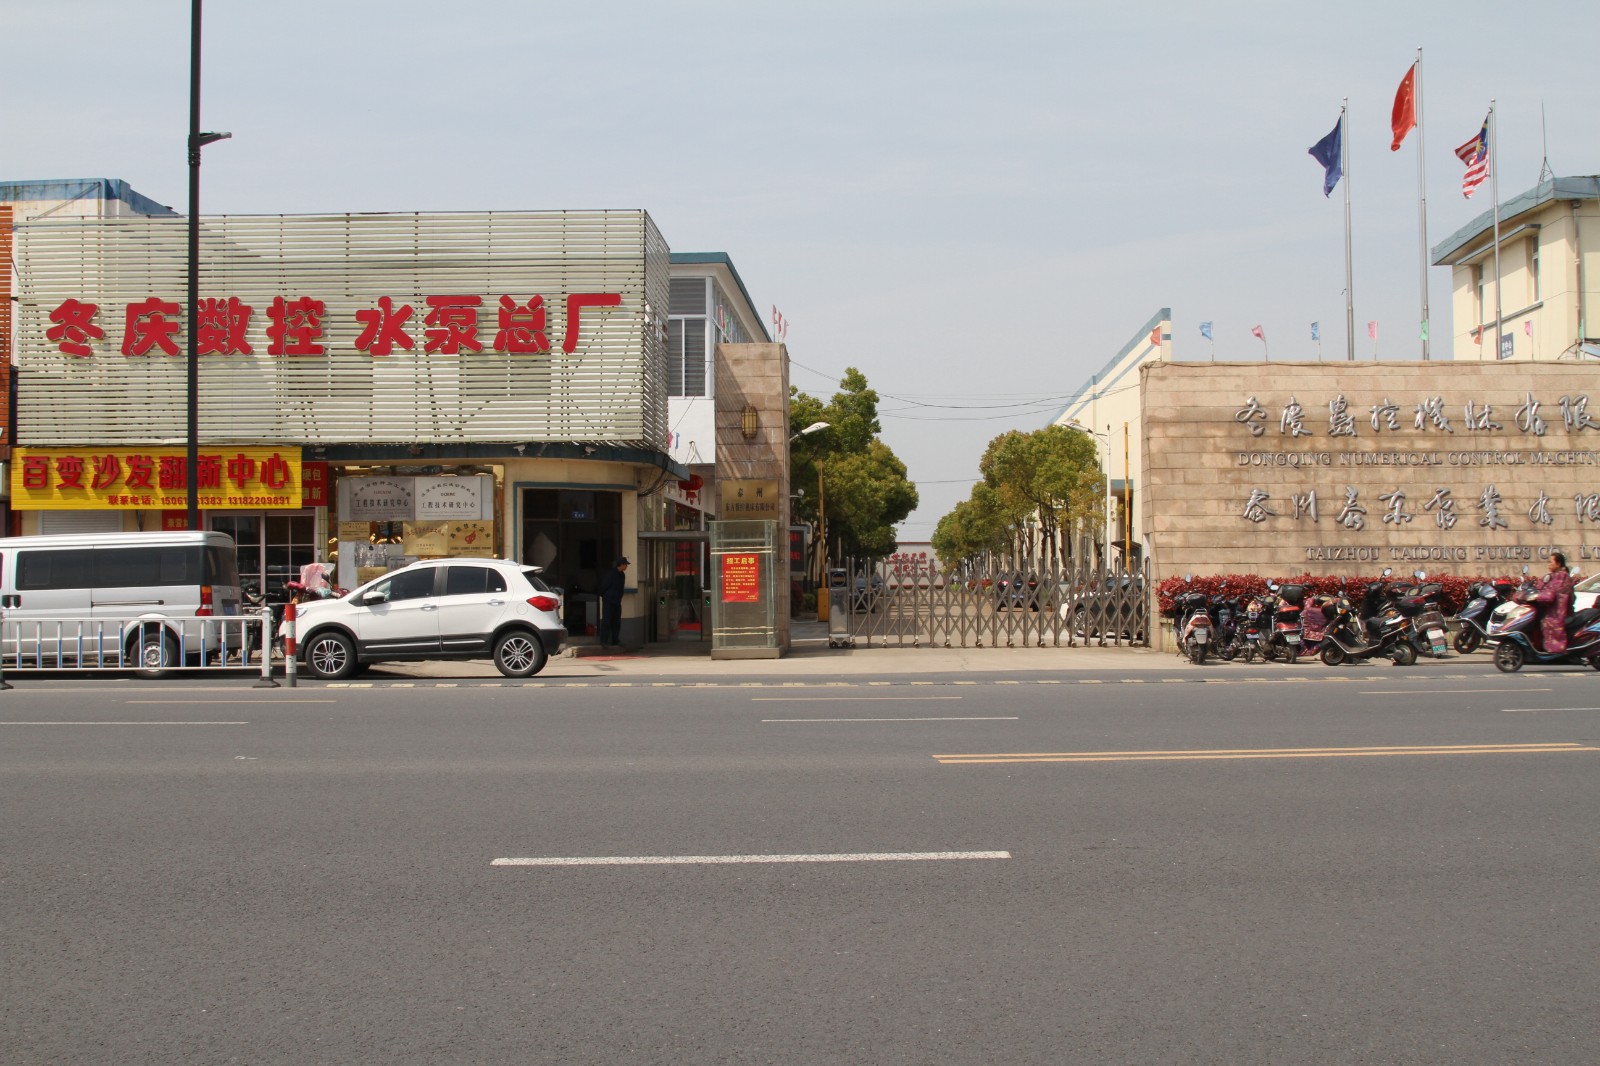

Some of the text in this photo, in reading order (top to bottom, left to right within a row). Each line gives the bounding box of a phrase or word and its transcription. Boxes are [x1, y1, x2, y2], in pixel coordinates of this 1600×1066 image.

[46, 294, 622, 357] 冬庆数控水泵总厂
[1238, 453, 1331, 467] DONGQING
[1340, 453, 1442, 465] NUMERICAL
[1448, 452, 1526, 465] CONTROL
[21, 452, 290, 490] 百变沙发翻新中心
[1305, 547, 1380, 560] TAIZHOU
[1389, 547, 1467, 560] TAIDONG
[1475, 546, 1531, 560] PUMPS
[726, 557, 755, 565] 招工启事
